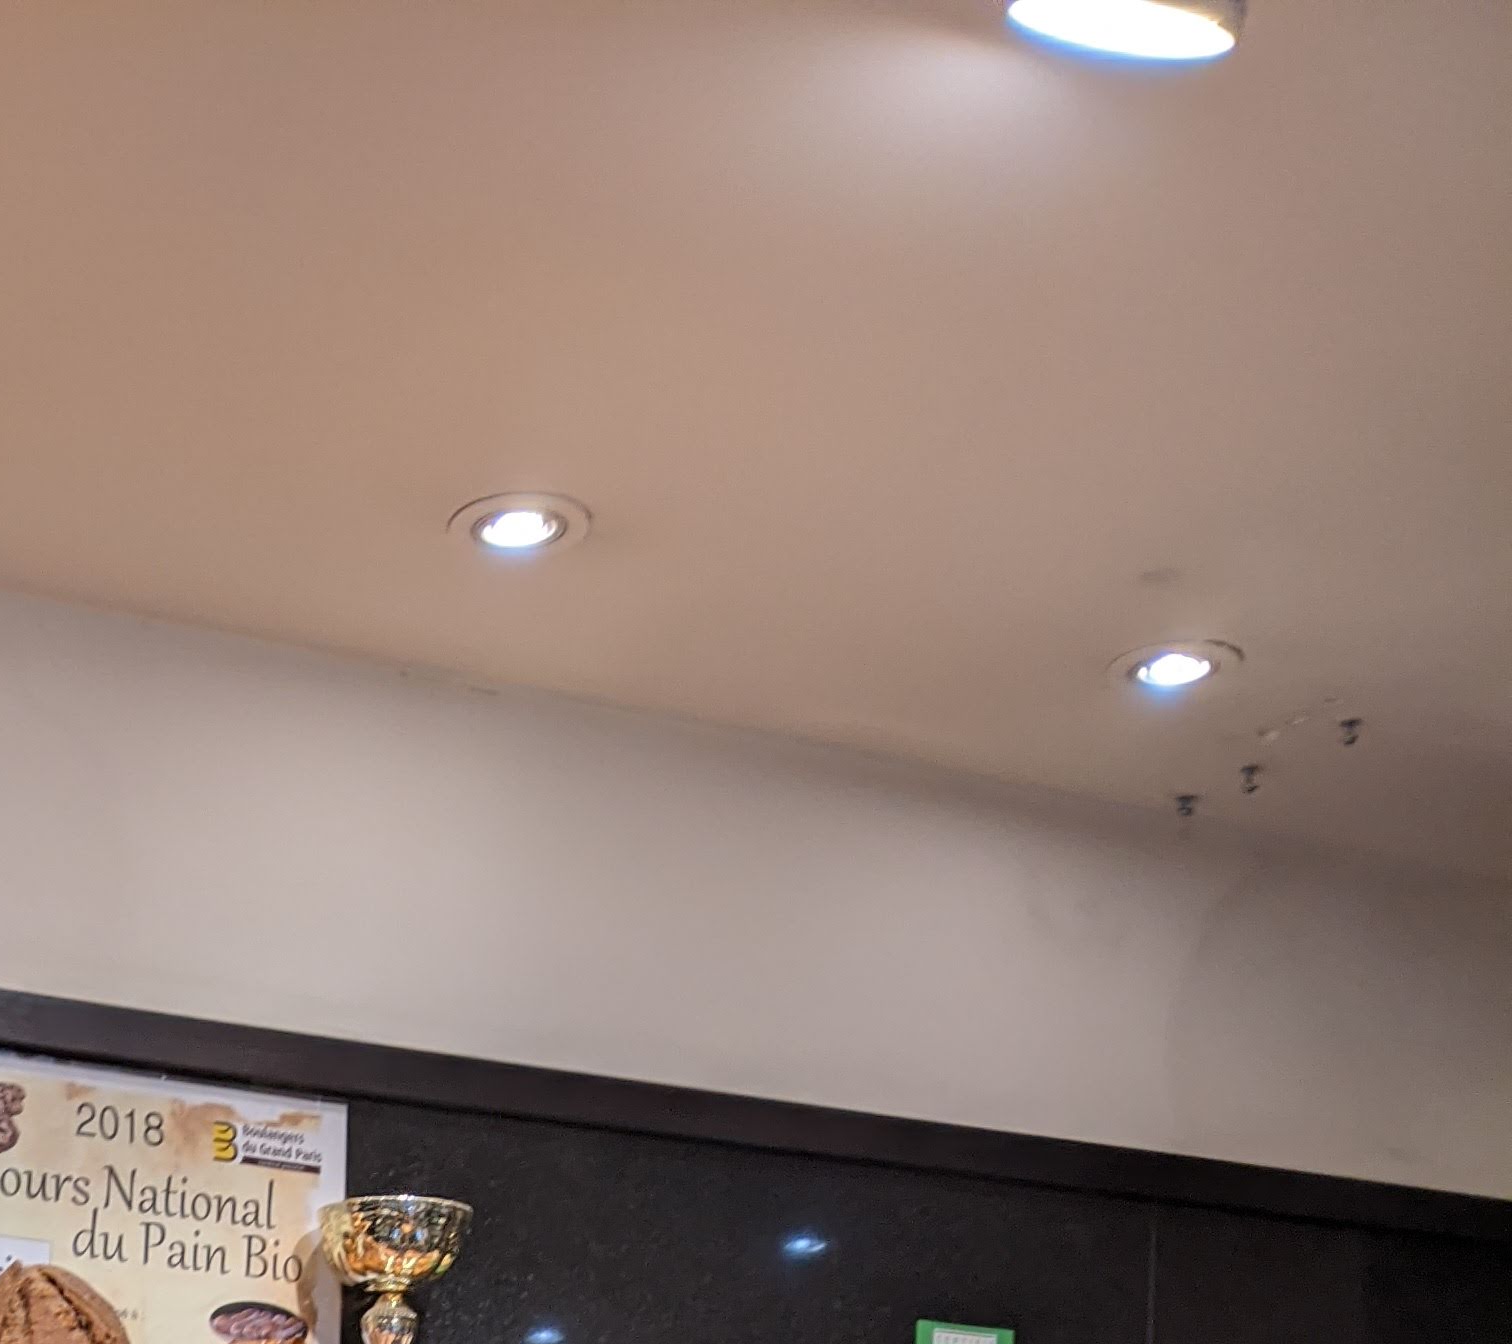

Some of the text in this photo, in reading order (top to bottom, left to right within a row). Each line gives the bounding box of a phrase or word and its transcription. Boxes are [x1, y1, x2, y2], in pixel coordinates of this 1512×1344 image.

[75, 1102, 165, 1148] 2018
[102, 1165, 276, 1230] National
[71, 1207, 303, 1283] du Pain Bio
